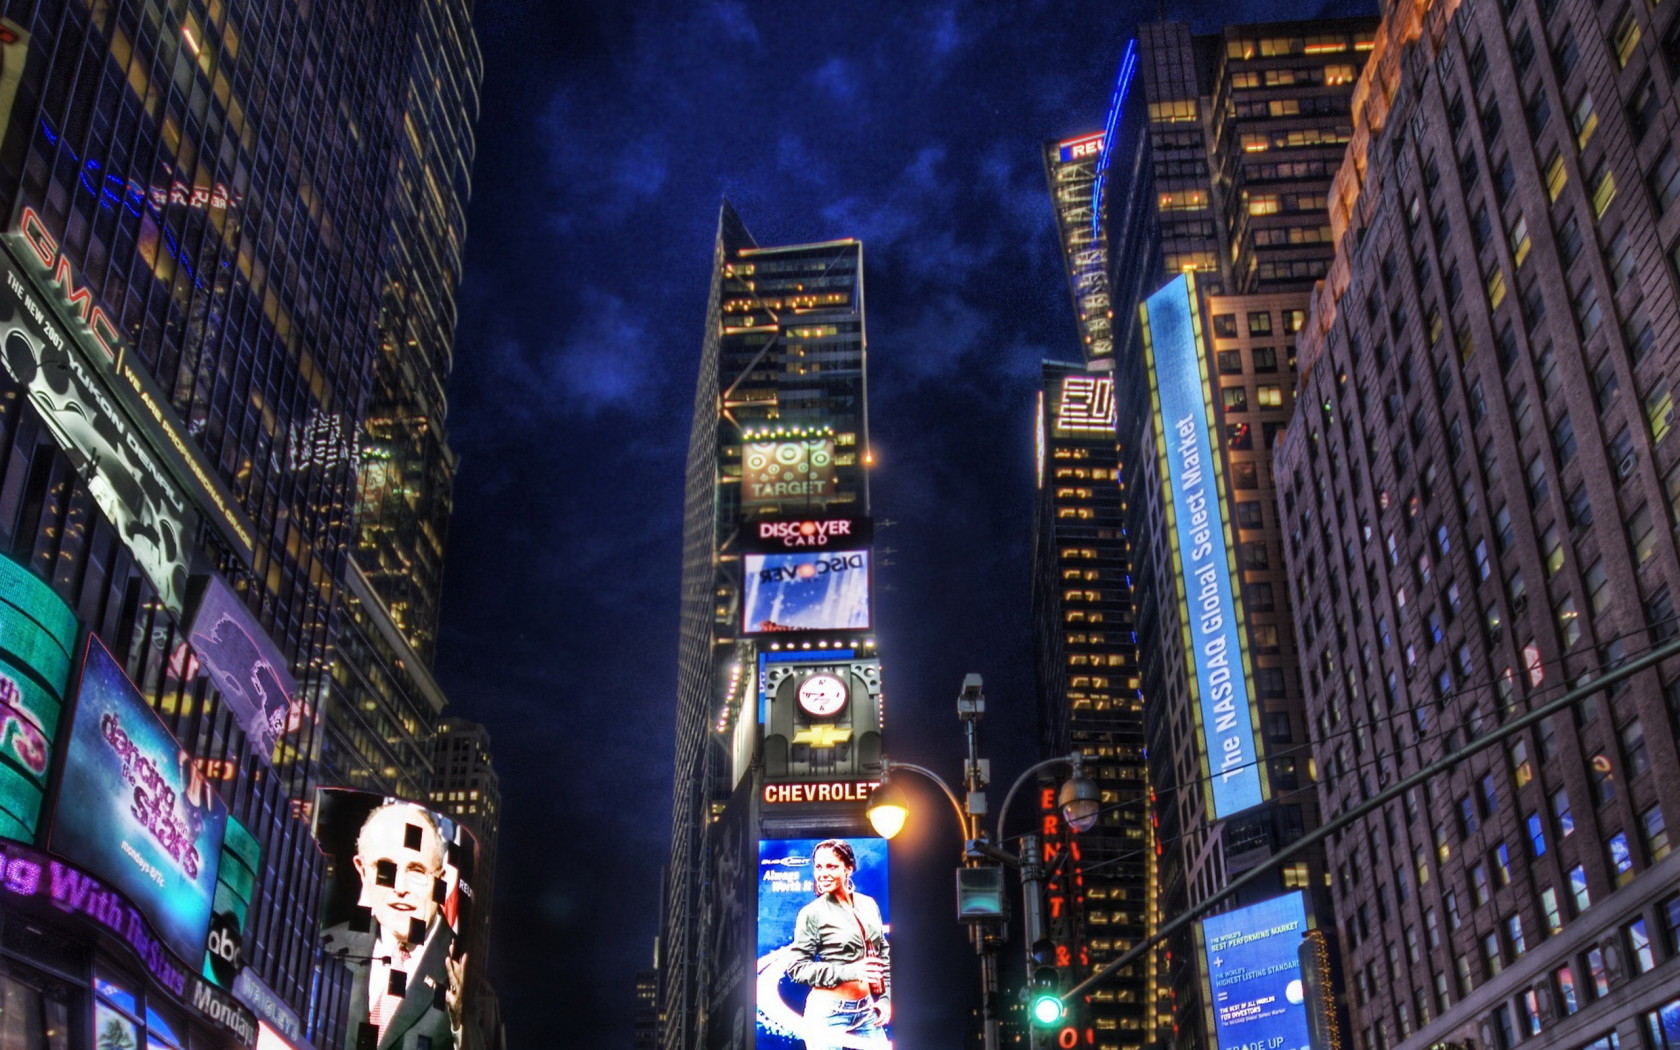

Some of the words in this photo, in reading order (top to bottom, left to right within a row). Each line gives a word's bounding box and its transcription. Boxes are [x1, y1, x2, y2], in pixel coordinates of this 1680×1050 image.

[21, 206, 119, 362] GMC
[8, 270, 24, 300] THE
[24, 294, 44, 325] NEW
[43, 321, 64, 352] 2007
[66, 350, 124, 434] YUKON
[127, 432, 184, 513] DENALI
[125, 365, 142, 393] WE
[141, 392, 162, 423] ARE
[162, 419, 224, 513] PROFESSIONAL
[225, 509, 253, 551] GRADE
[1177, 413, 1202, 490] Market
[752, 480, 826, 496] TARGET
[760, 520, 851, 538] DISCOVER
[783, 535, 828, 547] CARD
[1186, 489, 1213, 561] Select
[1198, 562, 1223, 635] Global
[1210, 636, 1238, 734] NASDAQ
[101, 713, 176, 818] dancing
[122, 763, 136, 787] the
[1223, 736, 1243, 784] The
[764, 783, 880, 802] CHEVROLET
[51, 860, 122, 932] With
[1211, 942, 1228, 952] BEST
[1228, 930, 1270, 948] PERFORMING
[1271, 921, 1299, 937] MARKET
[1216, 975, 1242, 988] HIGHEST
[1242, 969, 1267, 981] LISTING
[1221, 1013, 1231, 1021] FOR
[1268, 1037, 1284, 1049] UP
